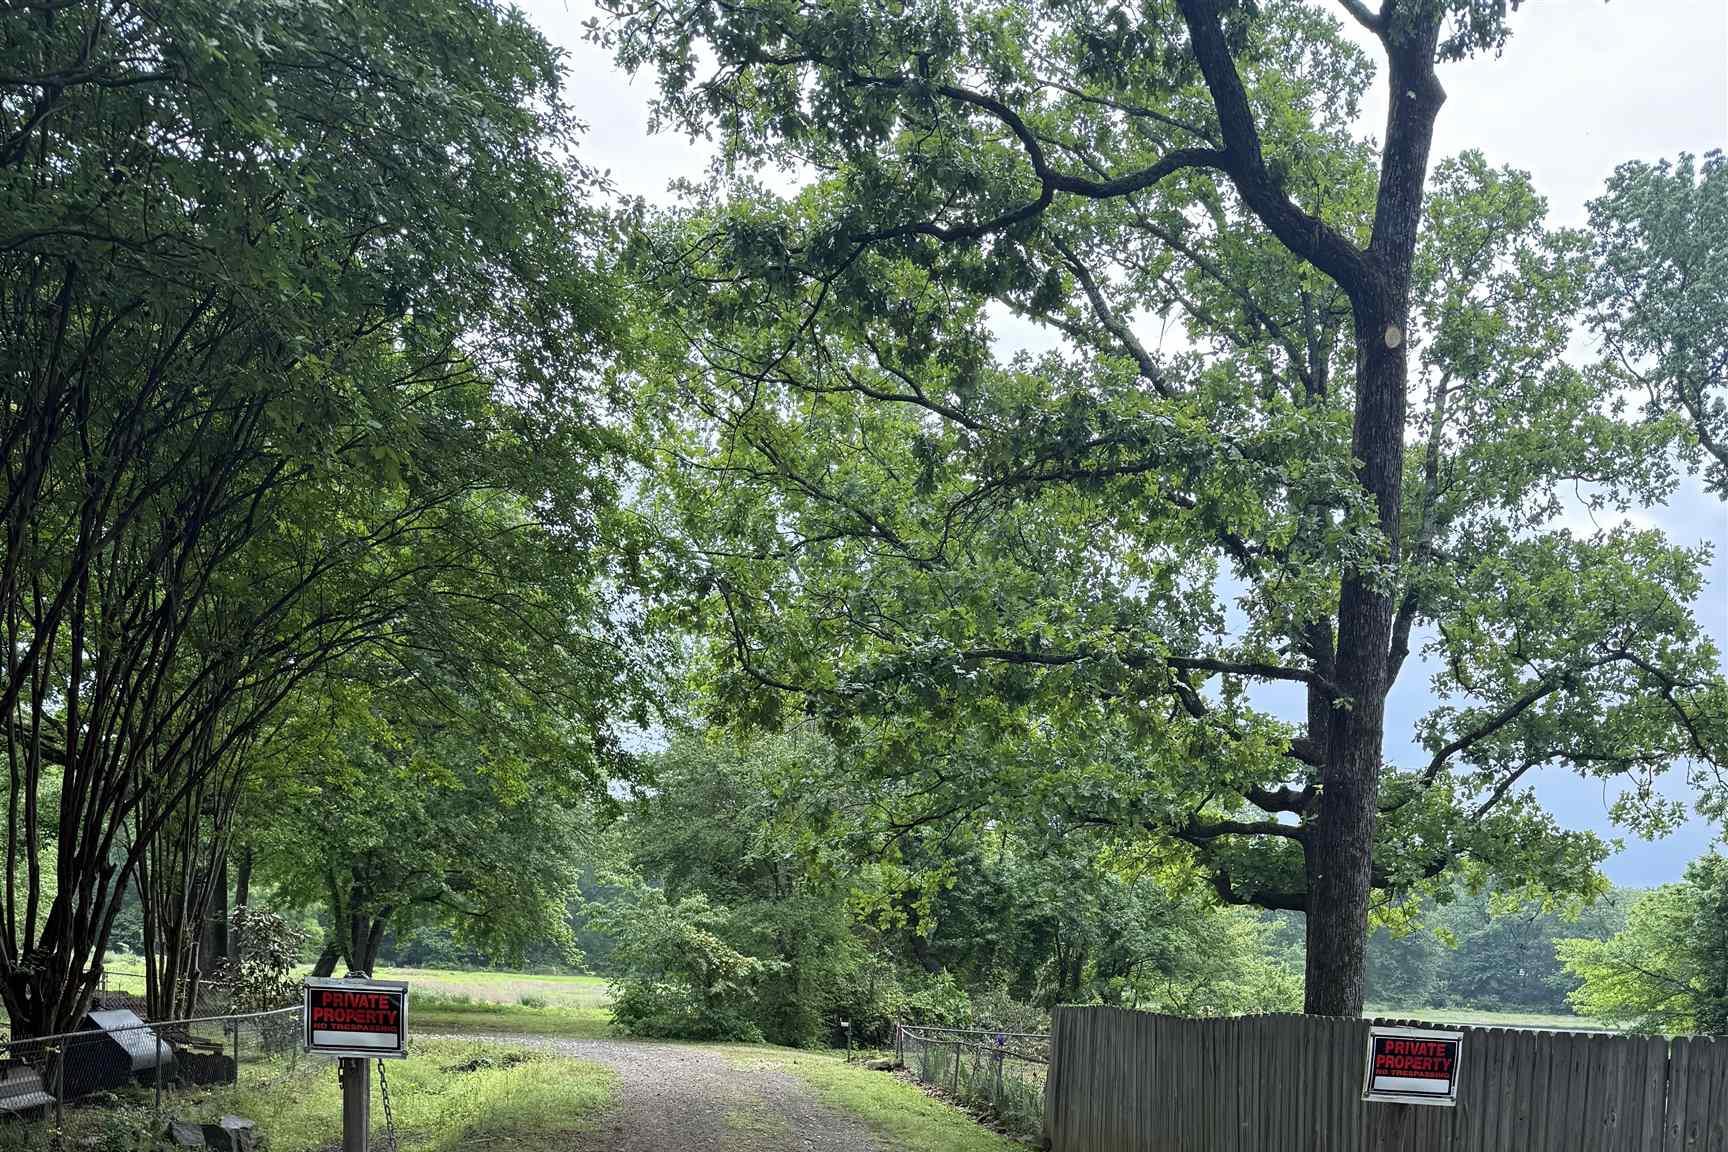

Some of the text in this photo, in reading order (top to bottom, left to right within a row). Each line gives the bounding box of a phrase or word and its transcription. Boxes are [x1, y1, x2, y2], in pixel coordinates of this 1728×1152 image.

[322, 991, 390, 1009] PRIVATE
[313, 1007, 397, 1025] PROPERTY
[313, 1022, 397, 1032] NO TRESPASSING
[1384, 1040, 1447, 1056] PRIVATE
[1375, 1054, 1452, 1071] PROPERTY
[1391, 1070, 1450, 1078] TRESPASSING
